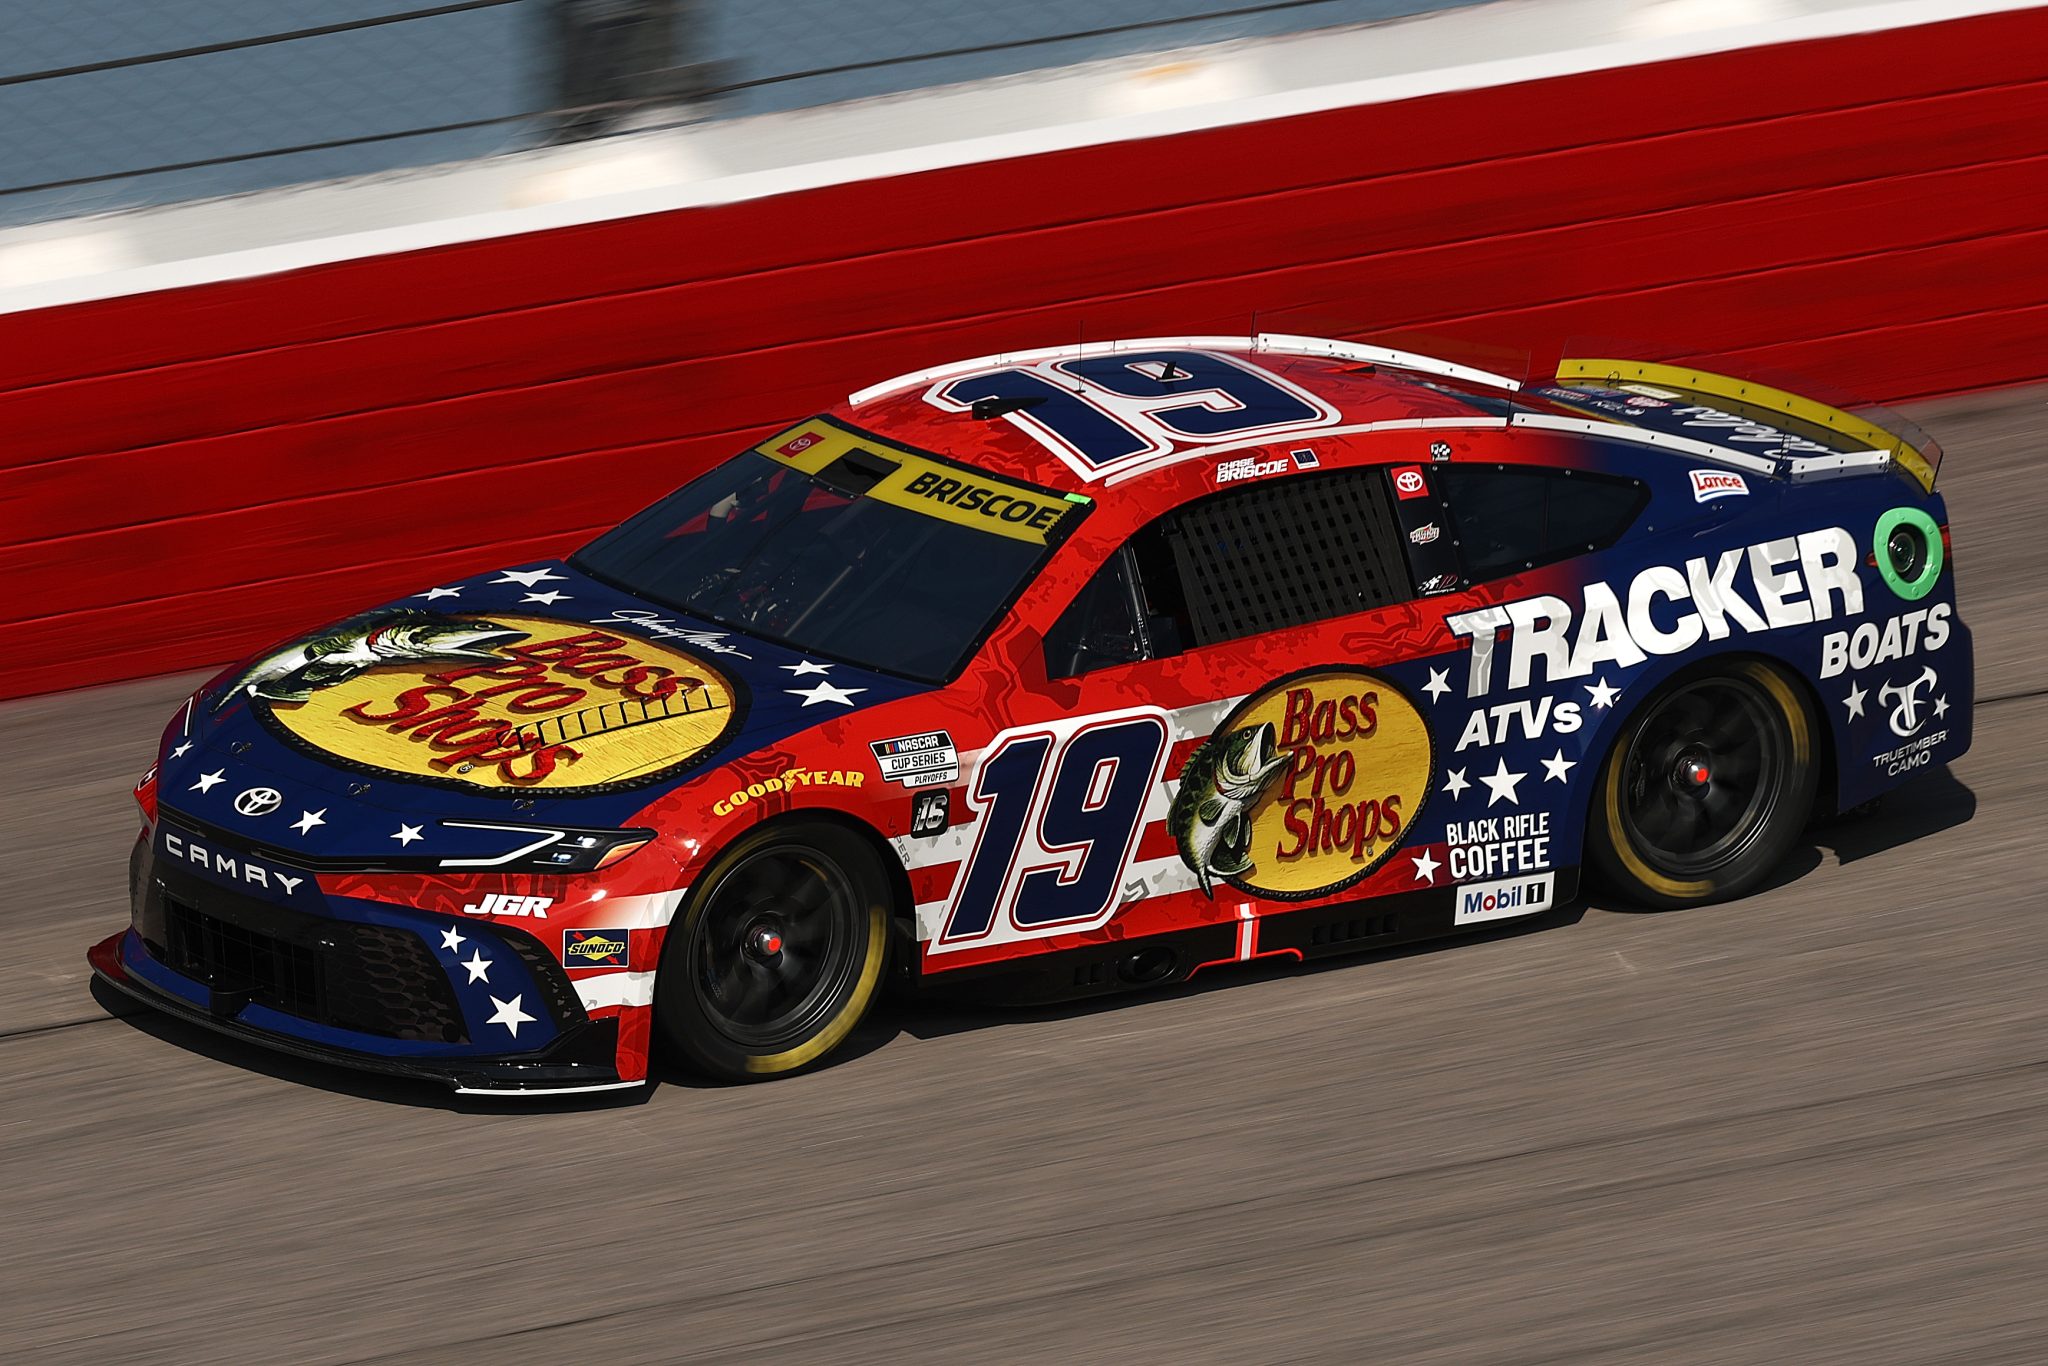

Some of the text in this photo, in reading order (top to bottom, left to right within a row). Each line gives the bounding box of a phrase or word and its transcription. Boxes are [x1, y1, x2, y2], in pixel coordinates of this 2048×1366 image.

[934, 348, 1332, 476] 19
[1216, 459, 1289, 483] BRISCOE
[1218, 457, 1255, 471] CHASE
[1693, 473, 1743, 491] Lance
[904, 471, 1064, 530] BRISCOE
[1446, 526, 1865, 699] TRACKER
[1819, 602, 1952, 680] BOATS
[424, 656, 588, 714] Pro
[500, 631, 705, 701] Bass
[342, 685, 584, 785] Shops
[1277, 687, 1380, 750] Bass
[1454, 695, 1584, 752] ATVs
[891, 752, 946, 770] CUP SERIES
[897, 735, 940, 753] NASCAR
[1873, 730, 1948, 768] TRUETIMBER
[1887, 750, 1932, 777] CAMO
[712, 767, 865, 817] GOODYEAR
[914, 772, 948, 784] PLAYOFFS
[1278, 744, 1356, 801] Pro
[917, 794, 948, 832] 16
[936, 712, 1170, 947] 19
[1275, 793, 1402, 860] Shops
[1446, 812, 1550, 847] BLACK RIFLE
[165, 832, 304, 896] CAMRY
[1449, 836, 1550, 879] COFFEE
[463, 893, 554, 919] JGR
[1463, 885, 1522, 914] Mobil
[569, 942, 625, 956] SUNOCO
